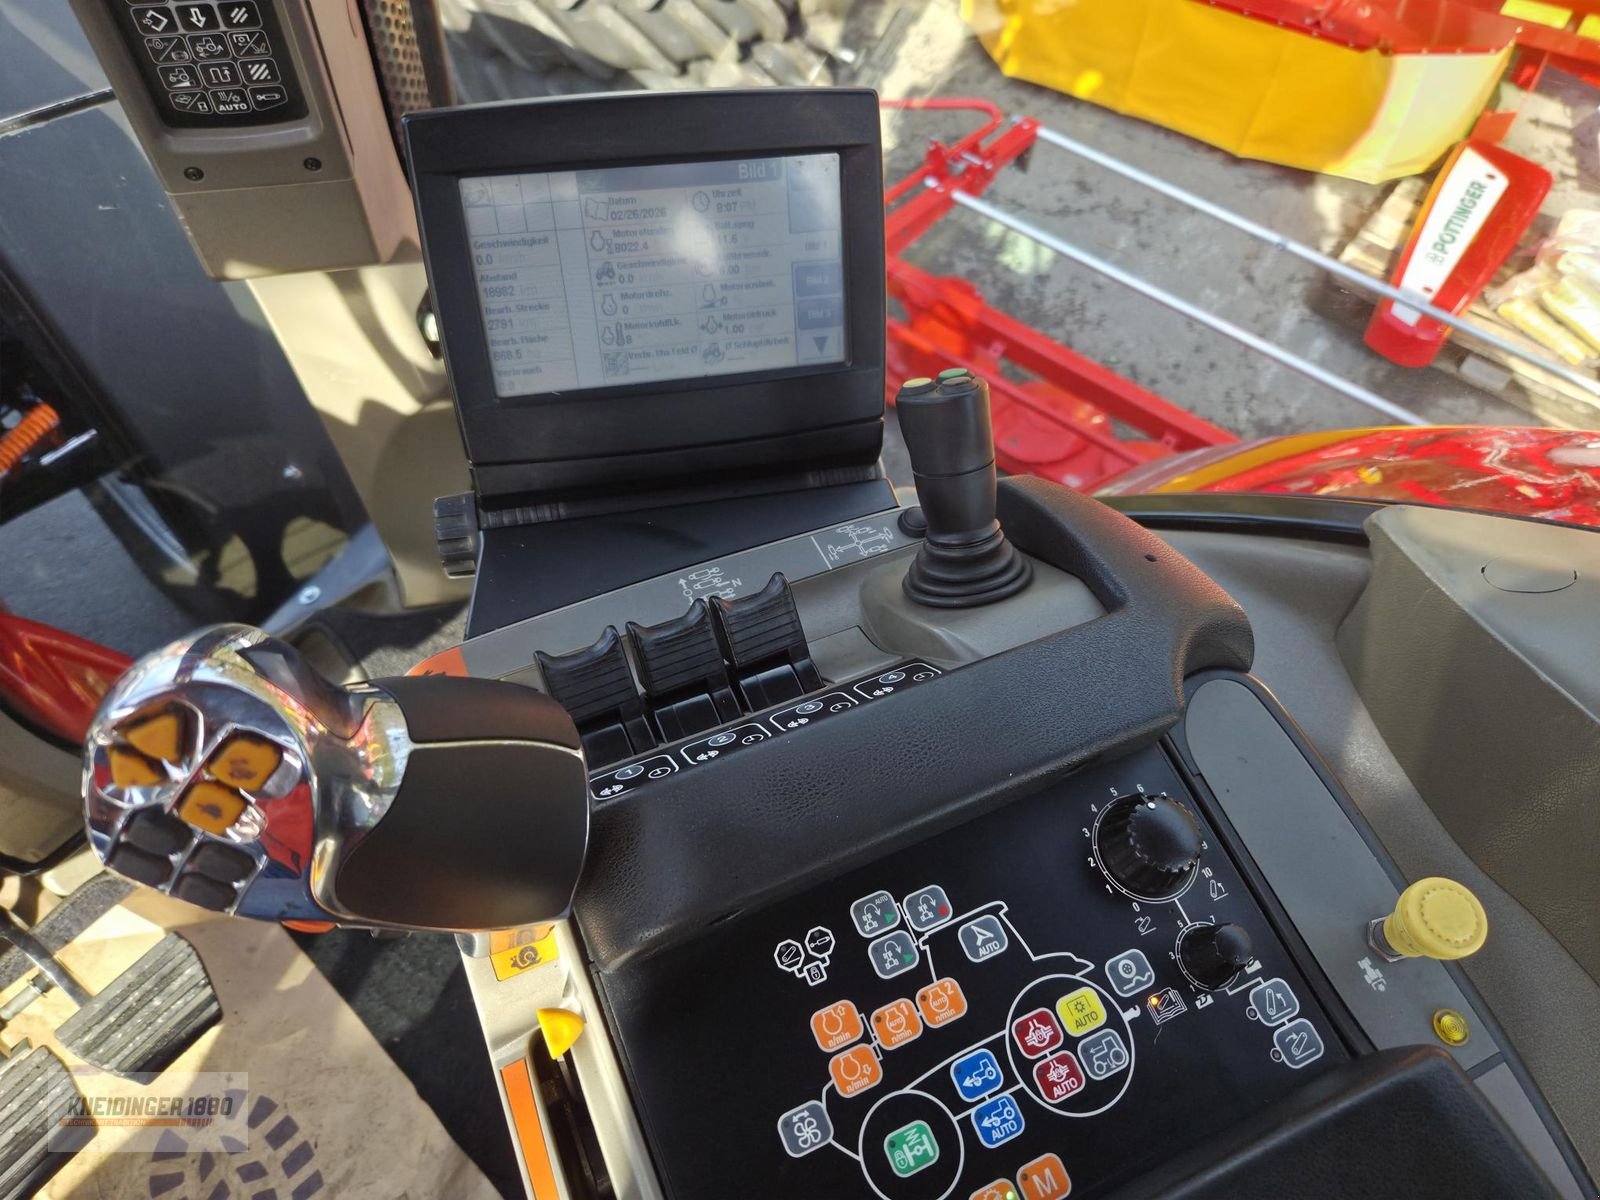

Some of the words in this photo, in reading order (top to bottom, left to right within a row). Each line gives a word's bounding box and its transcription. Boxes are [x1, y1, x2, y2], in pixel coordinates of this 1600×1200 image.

[219, 102, 248, 112] AUTO
[738, 162, 766, 179] Bild
[476, 253, 494, 266] 0.0
[1109, 786, 1118, 798] 5
[1136, 783, 1145, 794] 6
[1090, 803, 1098, 813] 4
[1082, 827, 1091, 838] 3
[1087, 856, 1097, 868] 2
[1201, 866, 1213, 879] 10
[1105, 883, 1113, 895] 1
[874, 894, 889, 906] AUTO
[1177, 919, 1184, 929] 5
[978, 940, 1000, 957] AUTO
[1168, 951, 1176, 960] 3
[944, 981, 955, 996] 2
[899, 1002, 910, 1016] 1
[1074, 1010, 1099, 1030] AUTO
[828, 1031, 852, 1048] n/min
[845, 1076, 870, 1094] n/min
[1052, 1077, 1079, 1099] AUTO
[991, 1120, 1018, 1142] AUTO
[1031, 1167, 1058, 1198] M
